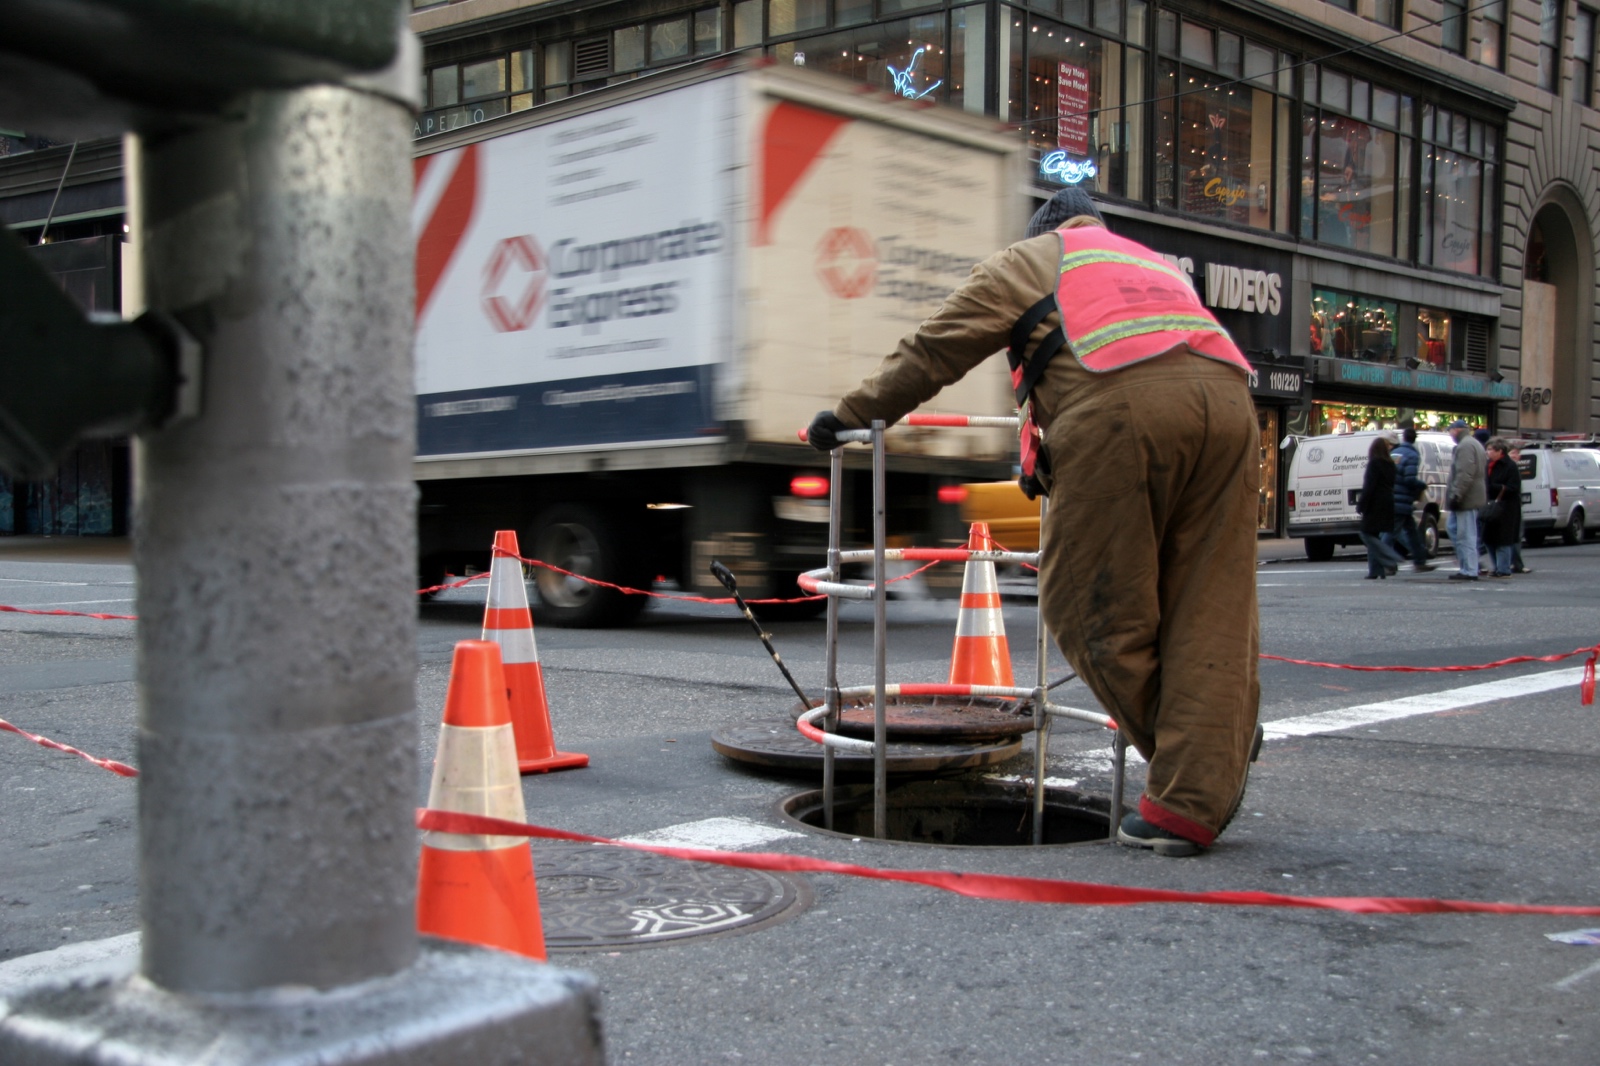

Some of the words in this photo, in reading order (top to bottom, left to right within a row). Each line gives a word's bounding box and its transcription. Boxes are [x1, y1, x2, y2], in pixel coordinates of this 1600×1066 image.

[1061, 64, 1072, 77] Buy
[1073, 68, 1085, 79] More
[1058, 76, 1072, 87] Save
[1073, 80, 1087, 92] More!
[413, 108, 484, 135] APEZIO
[547, 218, 725, 284] Corporate
[1205, 262, 1281, 316] VIDEOS
[546, 278, 680, 337] Express
[1270, 372, 1300, 392] 110/220
[1342, 364, 1385, 384] COMPUTERS
[1391, 370, 1412, 387] GIFTS
[1416, 373, 1448, 392] CAMERAS
[1521, 386, 1552, 406] 650
[1332, 463, 1358, 471] Consumer
